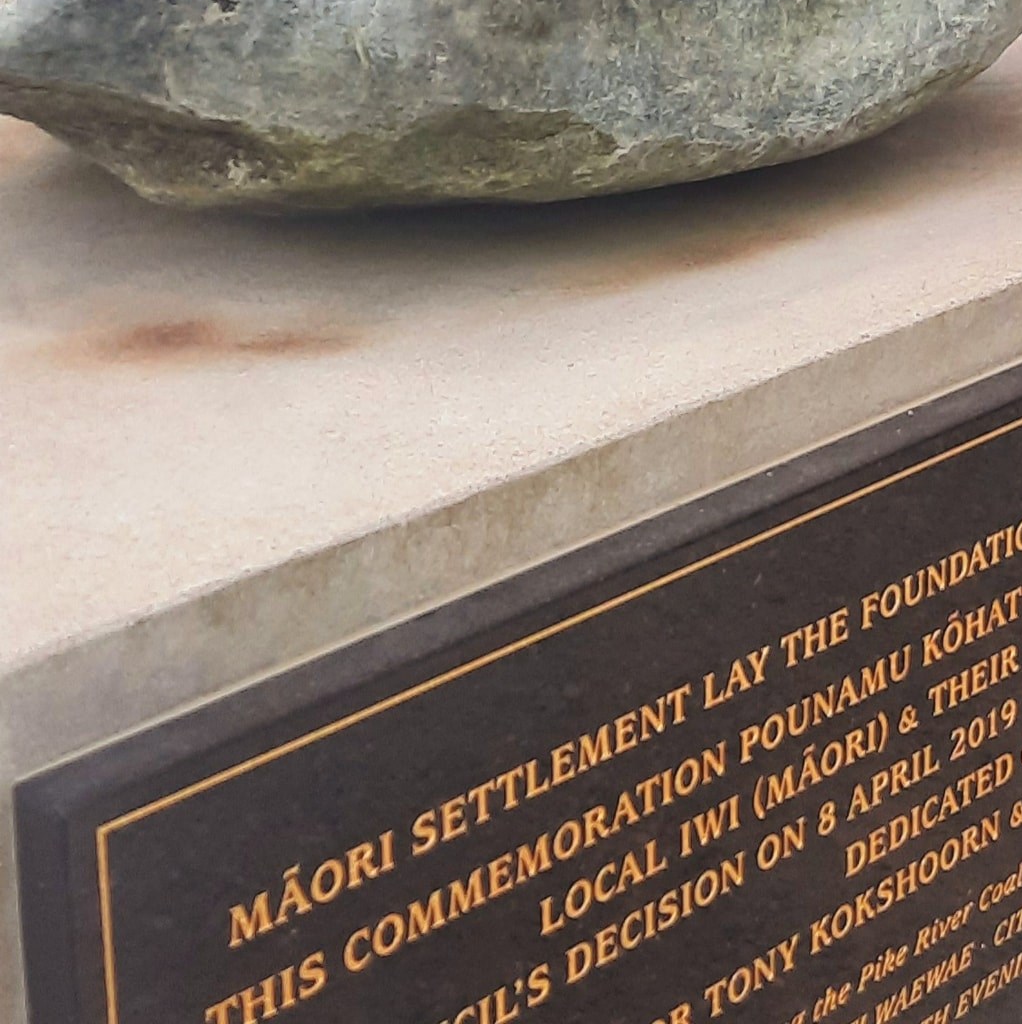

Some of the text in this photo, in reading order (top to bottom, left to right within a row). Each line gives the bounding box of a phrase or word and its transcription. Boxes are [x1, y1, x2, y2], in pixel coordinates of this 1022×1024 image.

[205, 950, 328, 1024] THIS
[343, 740, 727, 973] COMMEMORATION
[739, 644, 912, 764] POUNAMU
[411, 683, 692, 856] SETTLEMENT
[703, 645, 771, 711] LAY
[780, 607, 849, 668] THE
[539, 839, 668, 936] LOCAL
[679, 794, 741, 858] IWI
[898, 704, 918, 734] &
[928, 644, 1020, 716] THEIR
[565, 851, 746, 984] DECISION
[756, 816, 807, 871] ON
[817, 800, 837, 836] 8
[847, 744, 940, 821] APRIL
[950, 698, 1017, 760] 2019
[845, 752, 1015, 877] DEDICATED
[704, 933, 800, 1018] TONY
[809, 810, 1000, 955] KOKSHOORN
[813, 982, 852, 1023] the
[857, 942, 909, 993] Pike
[912, 900, 975, 956] River
[874, 942, 976, 1024] WAEWAE
